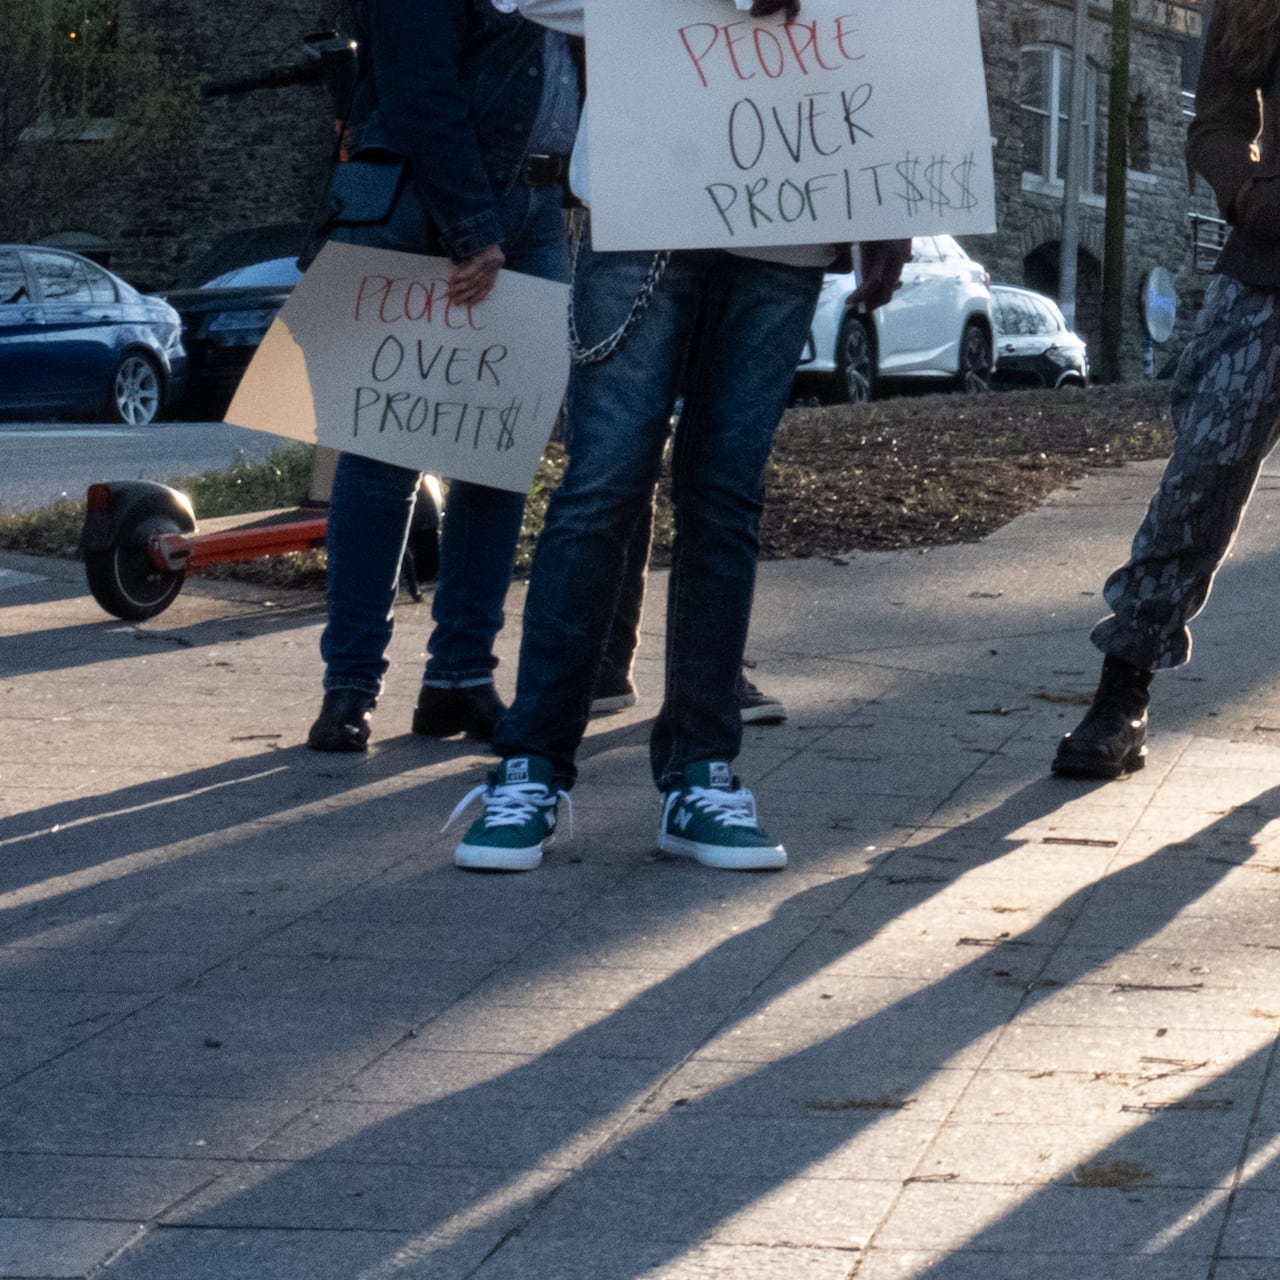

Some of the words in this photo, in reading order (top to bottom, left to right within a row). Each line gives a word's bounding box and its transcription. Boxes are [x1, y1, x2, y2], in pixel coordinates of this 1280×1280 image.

[678, 14, 866, 88] PEOPLE
[728, 83, 874, 170] OVER
[704, 150, 979, 237] PROFIT$$$
[371, 334, 508, 387] OVER
